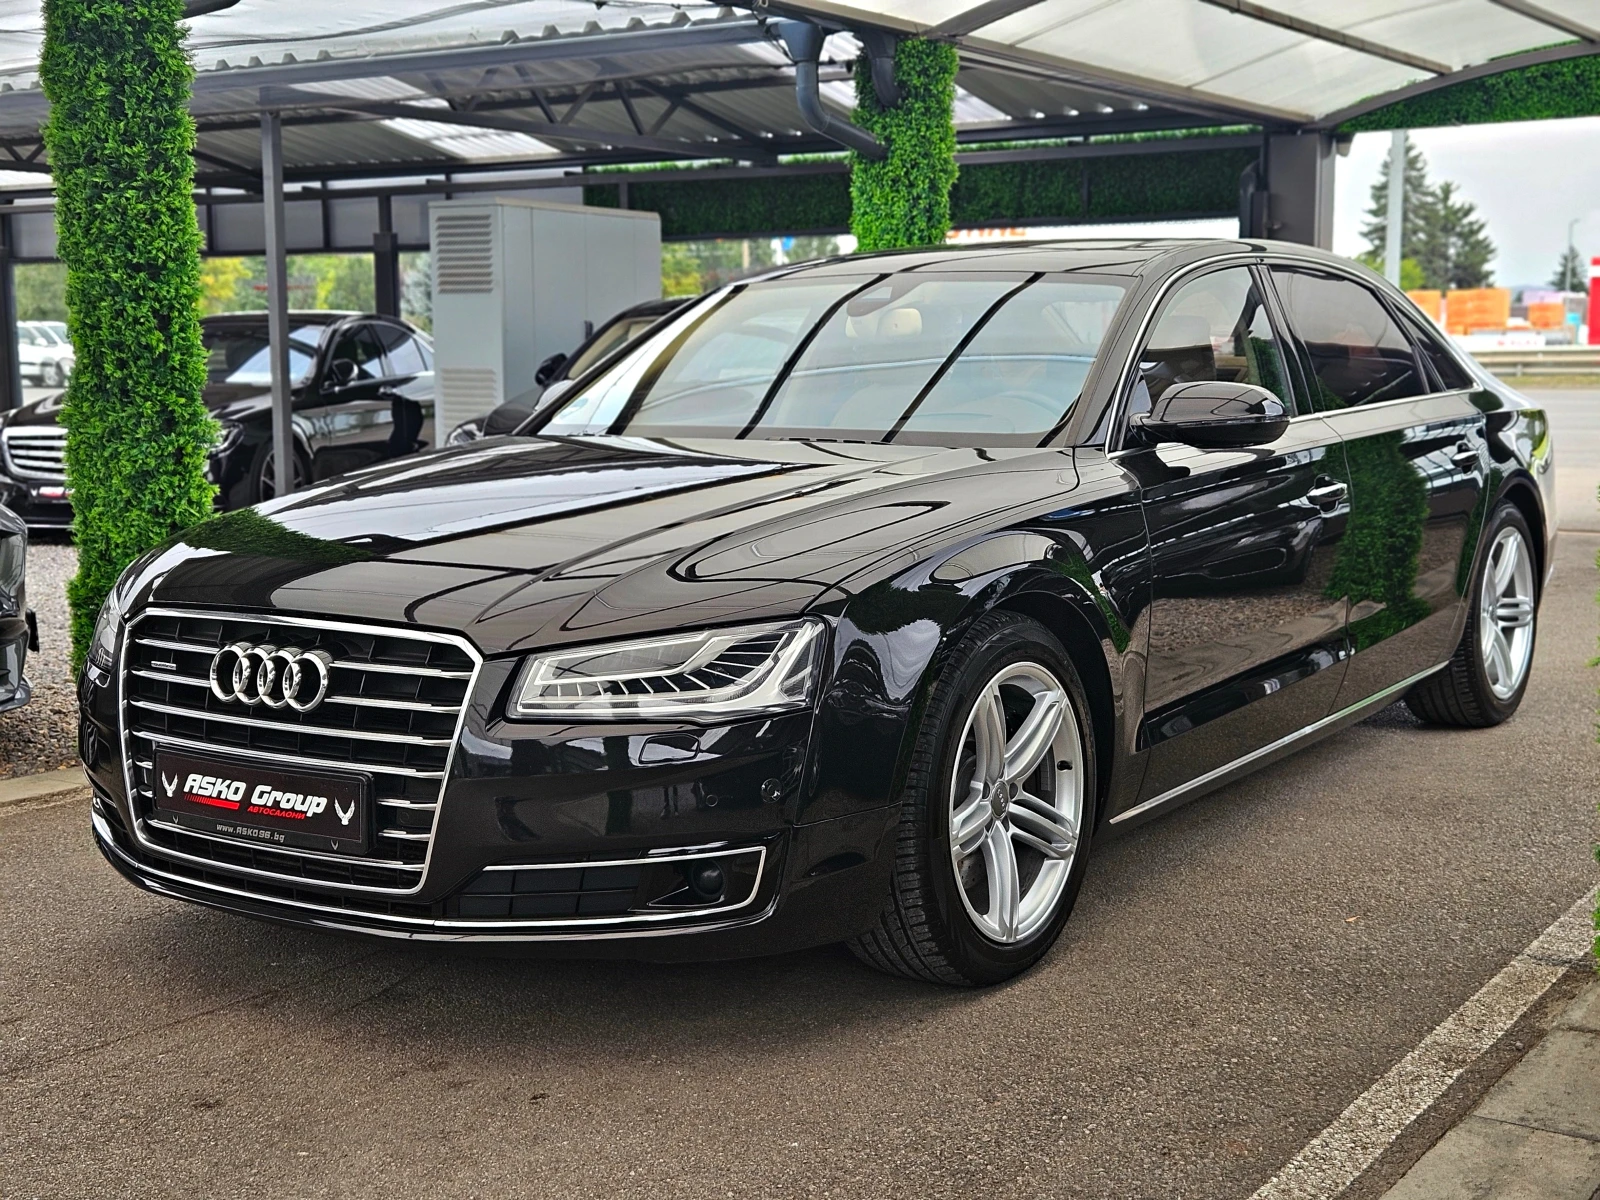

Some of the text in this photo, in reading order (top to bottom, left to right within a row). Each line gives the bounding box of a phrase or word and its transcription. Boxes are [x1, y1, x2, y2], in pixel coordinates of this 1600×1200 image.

[183, 773, 328, 817] ASKO Group
[247, 805, 306, 819] АВТОСАЛОНИ
[216, 824, 285, 842] www.ASKO96.bg
